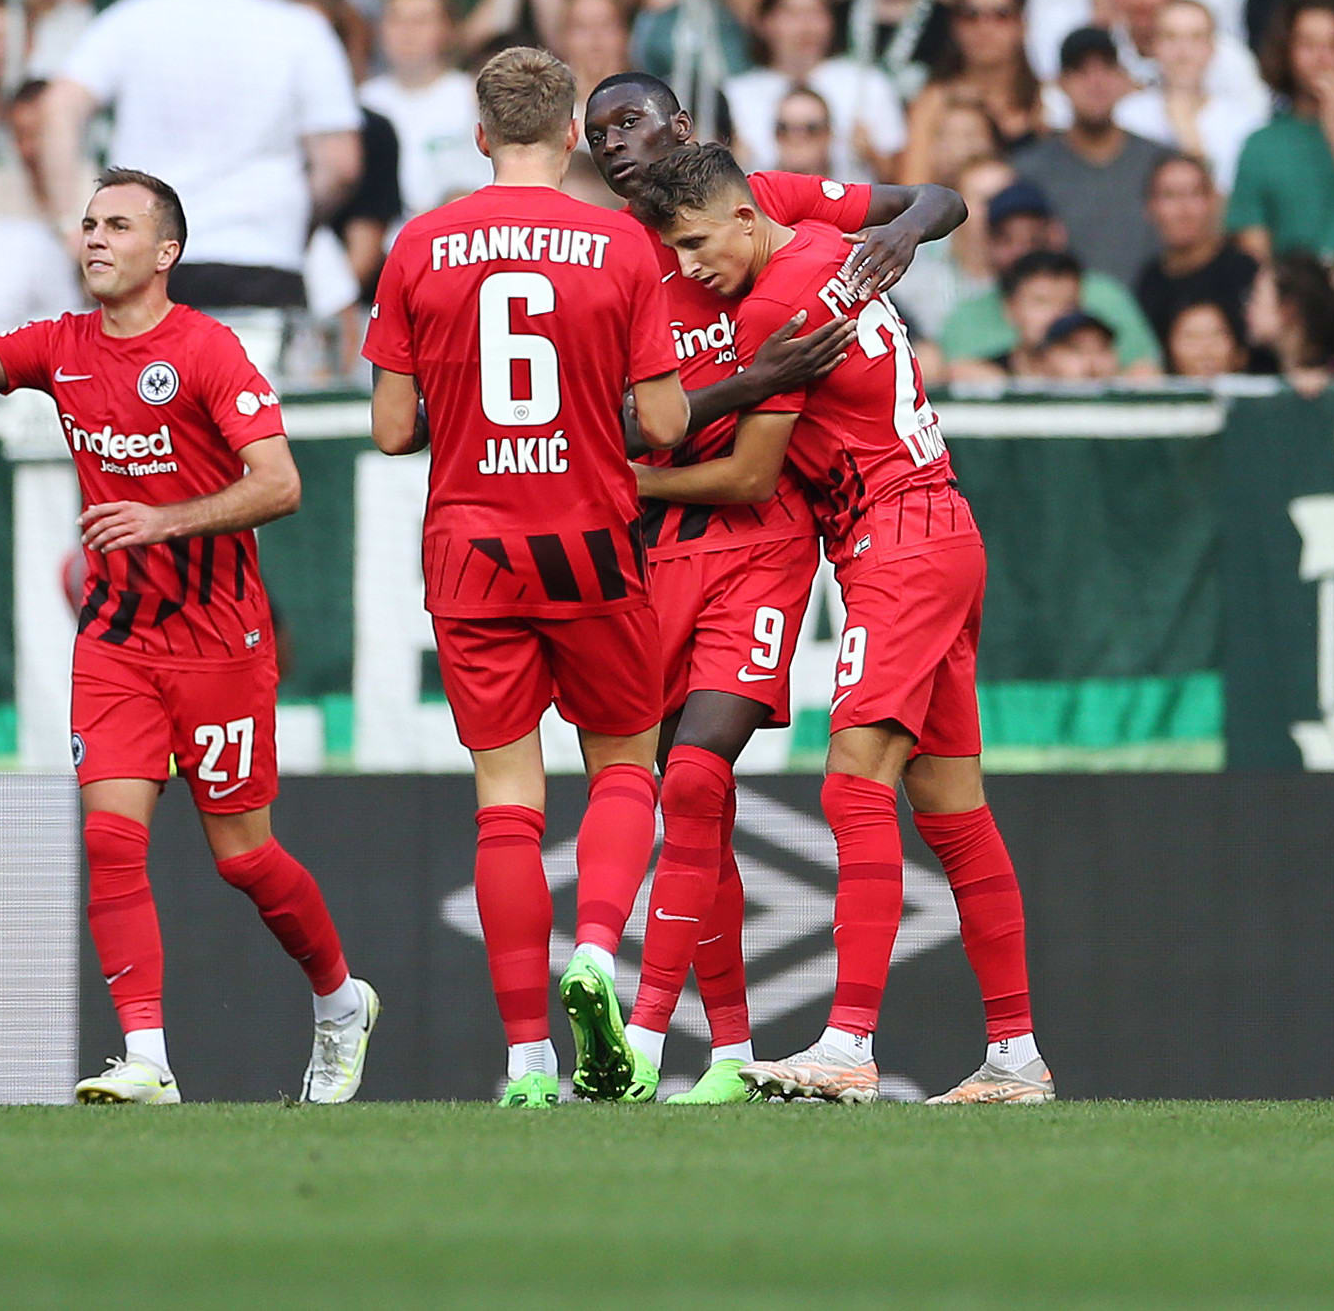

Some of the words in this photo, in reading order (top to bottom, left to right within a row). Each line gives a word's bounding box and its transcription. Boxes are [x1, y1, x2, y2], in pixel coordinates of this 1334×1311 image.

[432, 226, 610, 271] FRANKFURT
[478, 271, 561, 427] 6
[670, 312, 737, 361] ind
[62, 414, 173, 460] indeed
[478, 430, 570, 475] JAKIĆ
[127, 459, 178, 477] finden
[750, 605, 785, 669] 9
[194, 715, 255, 782] 27
